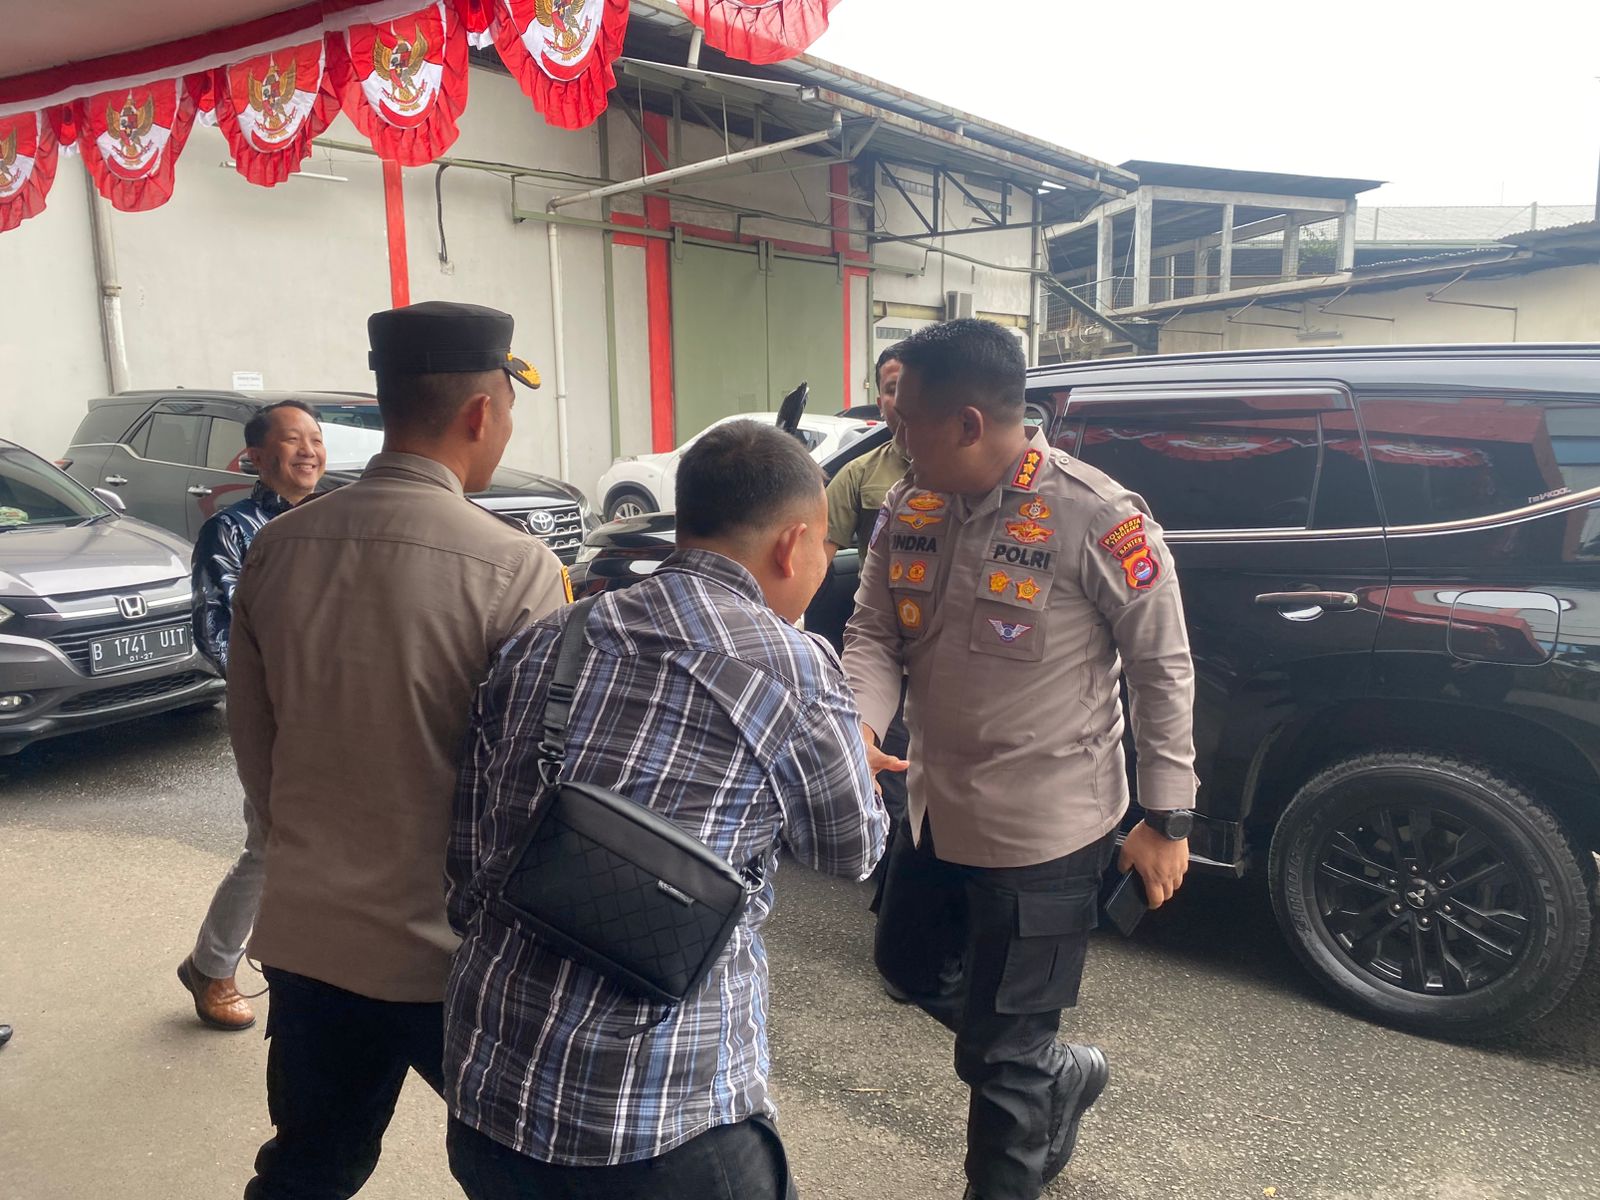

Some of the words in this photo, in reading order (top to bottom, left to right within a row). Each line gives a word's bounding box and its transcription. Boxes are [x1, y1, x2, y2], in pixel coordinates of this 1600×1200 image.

[893, 535, 937, 553] INDRA
[1104, 518, 1141, 545] POLRESTA
[993, 544, 1050, 570] POLRI
[1119, 537, 1143, 555] BANTEN
[93, 643, 103, 661] B
[115, 635, 147, 657] 1741
[160, 628, 184, 648] UIT
